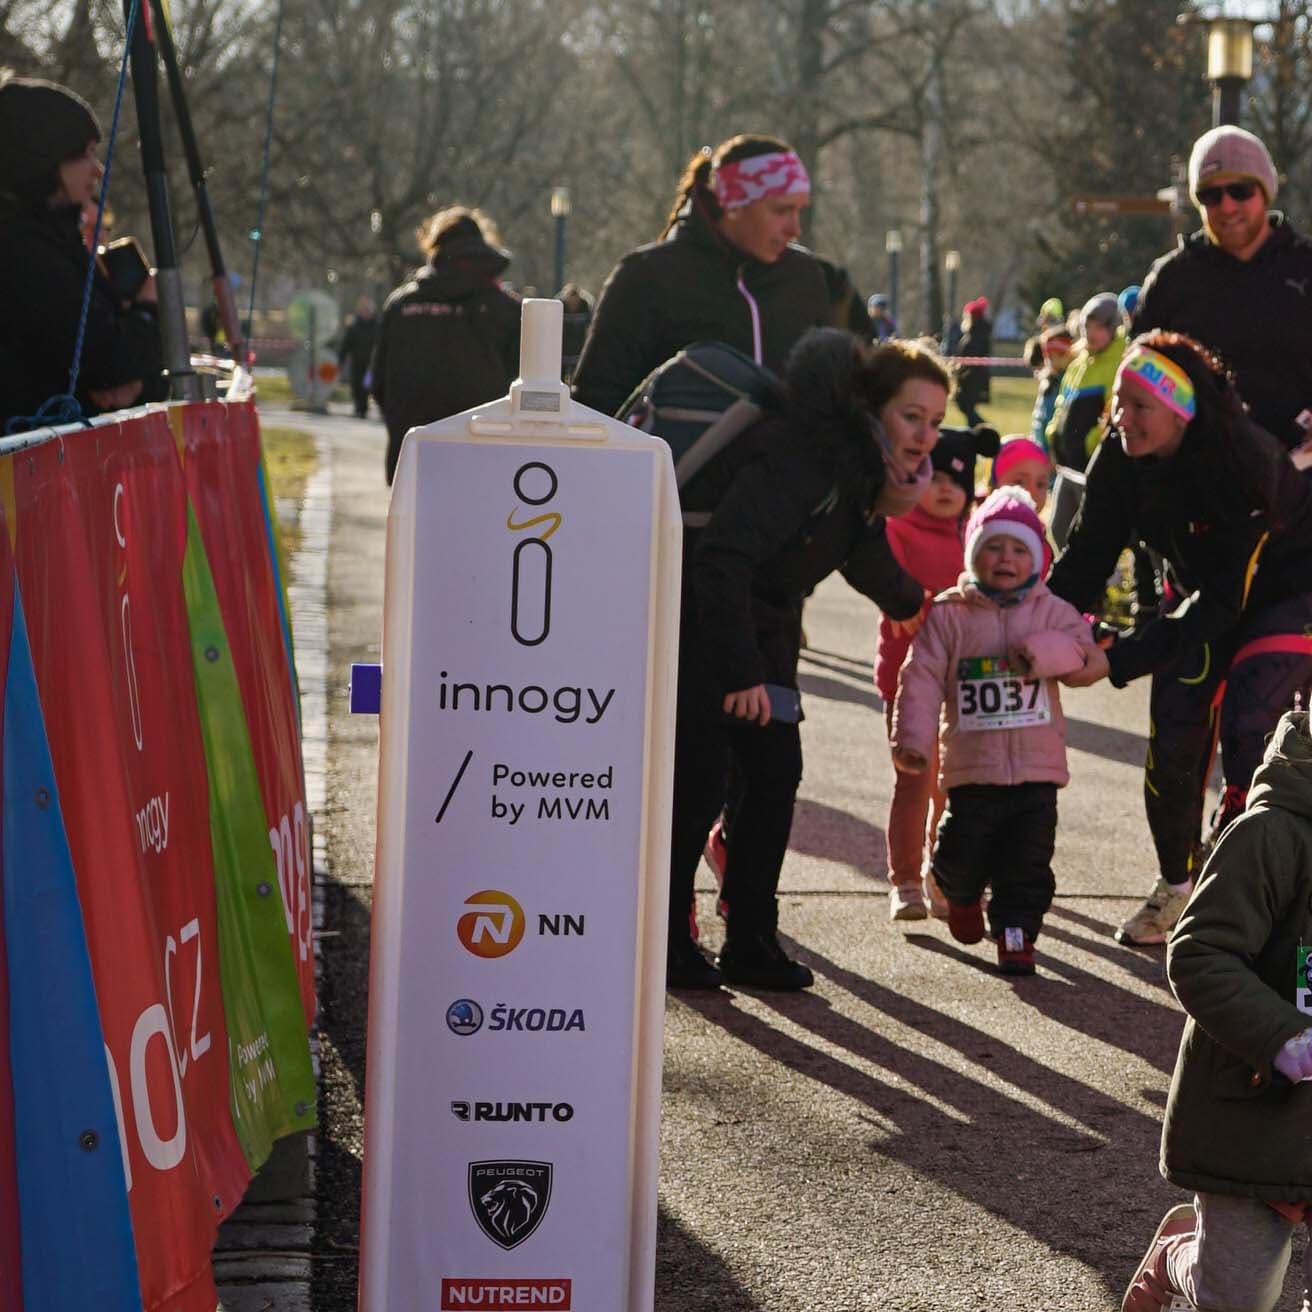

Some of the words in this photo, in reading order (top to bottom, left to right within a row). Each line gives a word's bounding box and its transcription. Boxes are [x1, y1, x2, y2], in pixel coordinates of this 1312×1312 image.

[439, 671, 616, 724] innogy
[960, 679, 1040, 715] 3037
[493, 764, 613, 790] Powered
[491, 795, 525, 824] by
[537, 797, 610, 821] MVM
[538, 914, 585, 936] NN
[489, 1003, 586, 1032] ŠKODA
[474, 1102, 575, 1122] RUNTO
[476, 1168, 544, 1178] PEUGEOT
[448, 1284, 565, 1306] NUTREND
